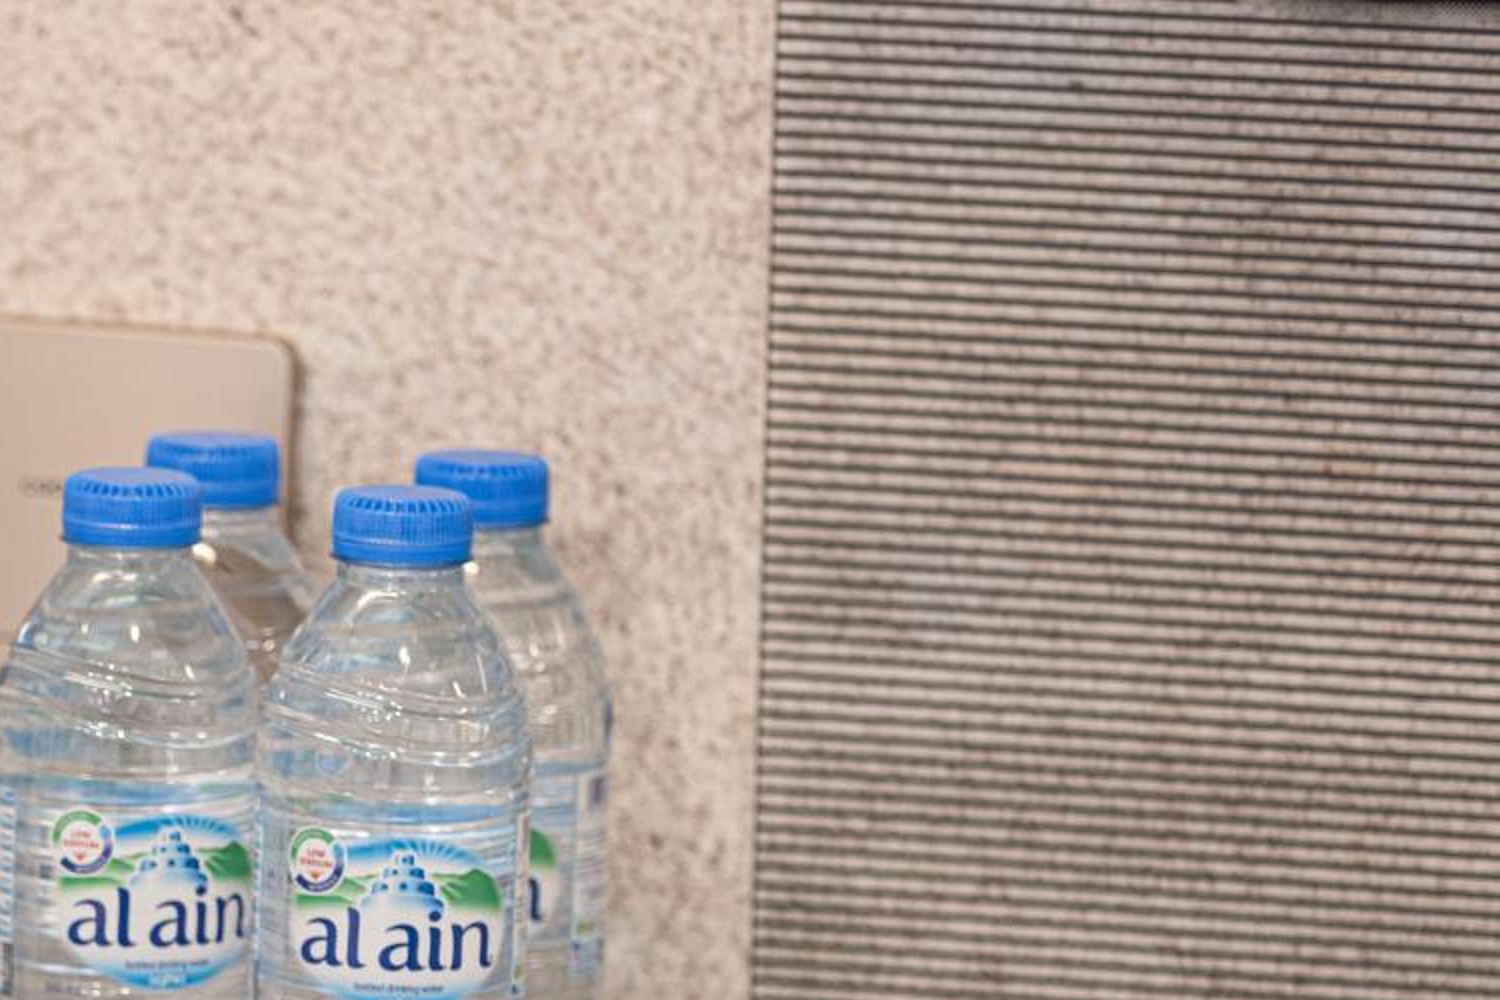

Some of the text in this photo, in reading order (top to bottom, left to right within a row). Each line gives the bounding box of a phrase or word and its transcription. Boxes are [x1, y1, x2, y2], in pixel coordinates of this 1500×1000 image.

[67, 884, 245, 948] al ain
[300, 907, 492, 972] al ain
